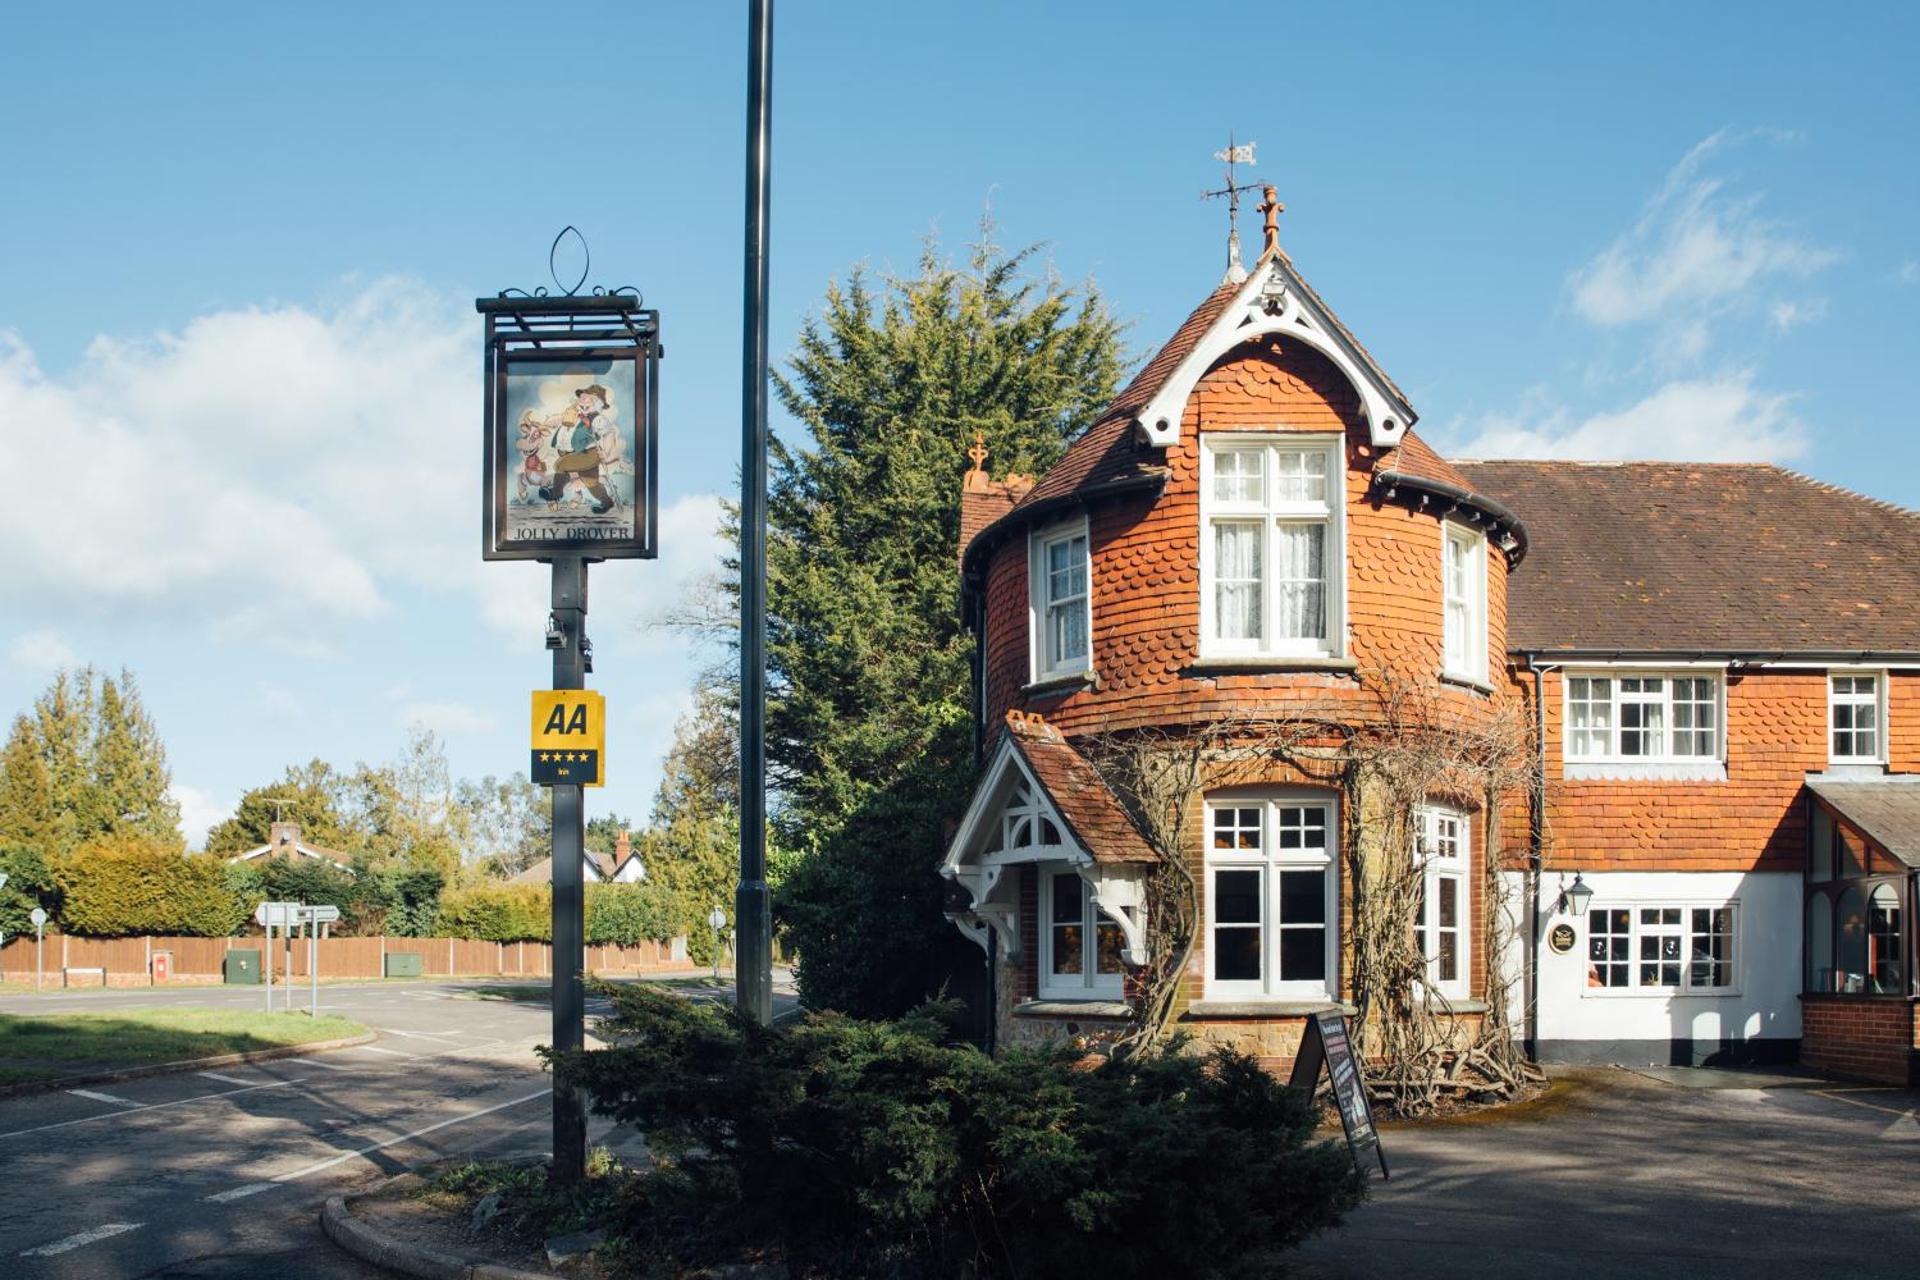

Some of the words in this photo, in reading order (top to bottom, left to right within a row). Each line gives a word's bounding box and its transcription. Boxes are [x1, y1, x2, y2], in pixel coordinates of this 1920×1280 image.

[514, 527, 560, 540] JOLLY
[566, 527, 629, 540] DROVER
[544, 704, 587, 735] AA
